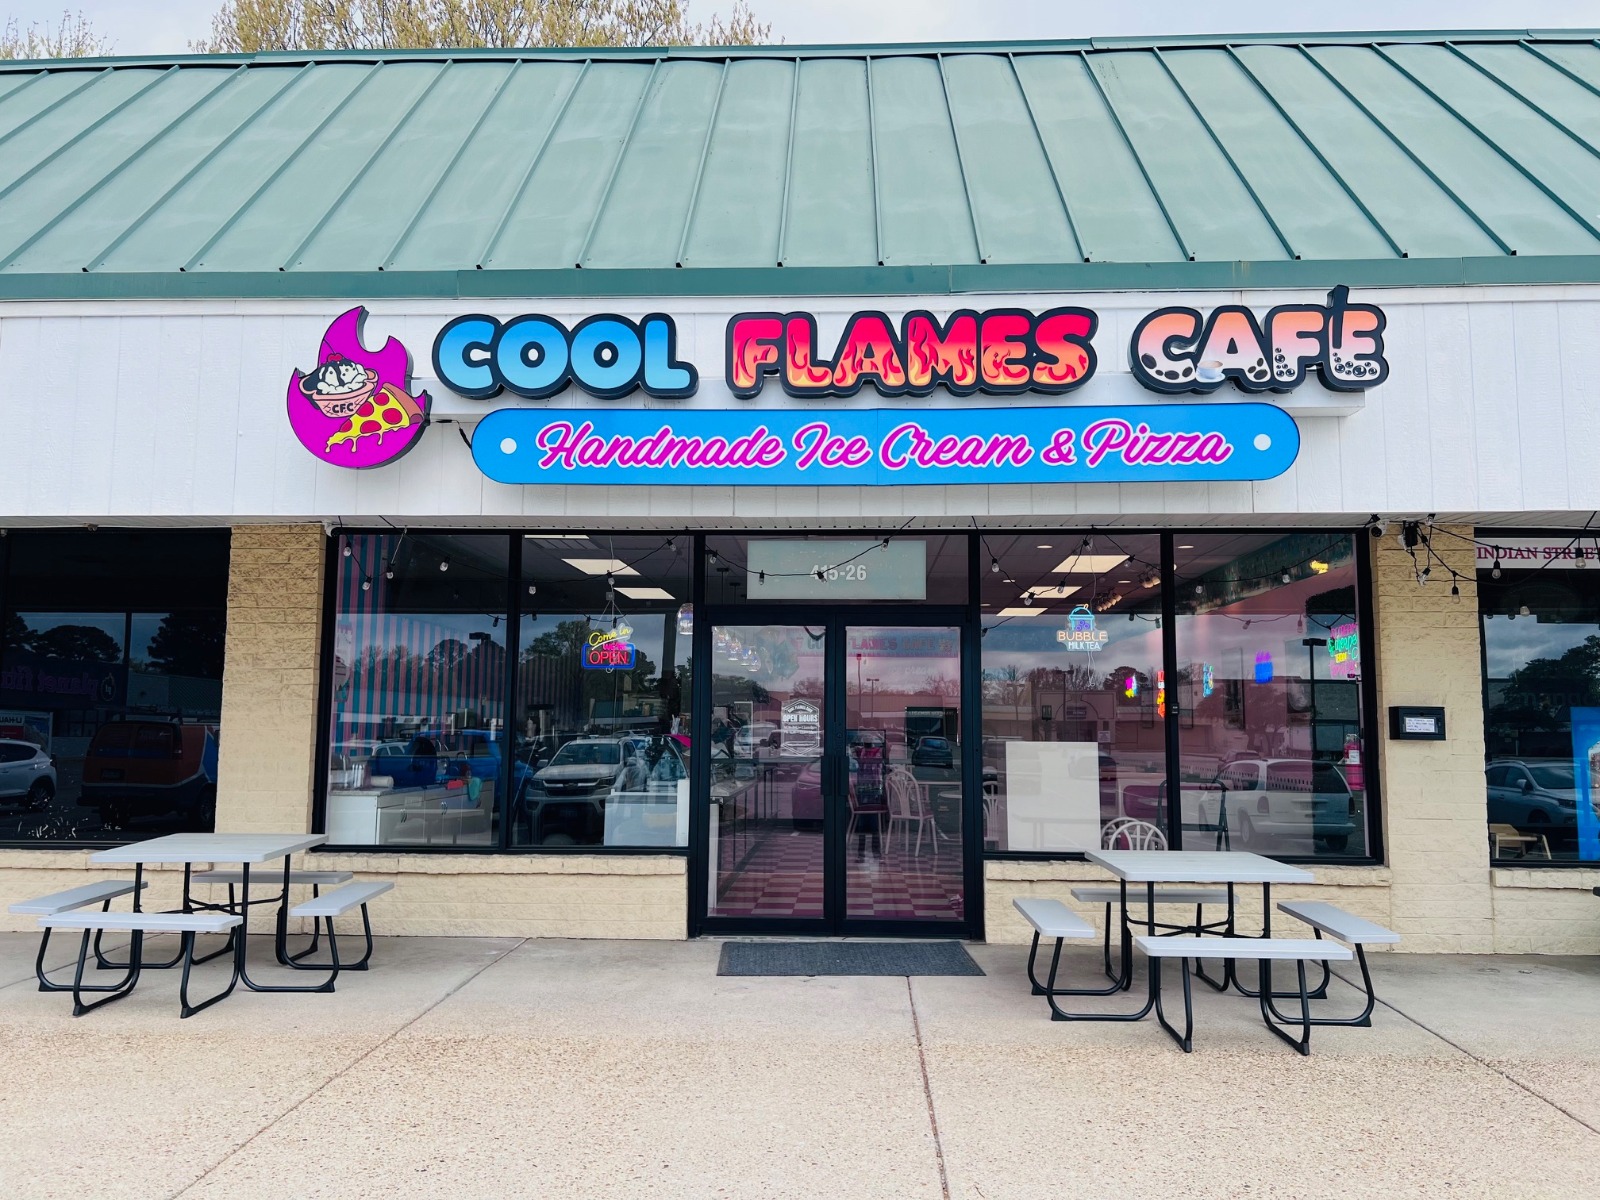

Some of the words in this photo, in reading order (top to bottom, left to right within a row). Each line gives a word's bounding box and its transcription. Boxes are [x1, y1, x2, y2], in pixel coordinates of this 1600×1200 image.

[433, 313, 698, 397] COOL
[727, 309, 1098, 395] FLAMES
[332, 403, 354, 413] CFC
[536, 420, 786, 470] Handmade
[793, 421, 871, 470] Ice
[880, 421, 1034, 470] Cream
[1041, 428, 1076, 466] &
[1081, 418, 1234, 468] Pizza
[1476, 547, 1538, 559] INDIAN
[1543, 547, 1600, 560] STRE
[810, 564, 867, 580] 415-26
[589, 632, 617, 646] Come
[1058, 631, 1107, 641] BUBBLE
[1085, 641, 1101, 650] TEA
[590, 651, 628, 664] OPEN
[783, 714, 798, 722] OPEN
